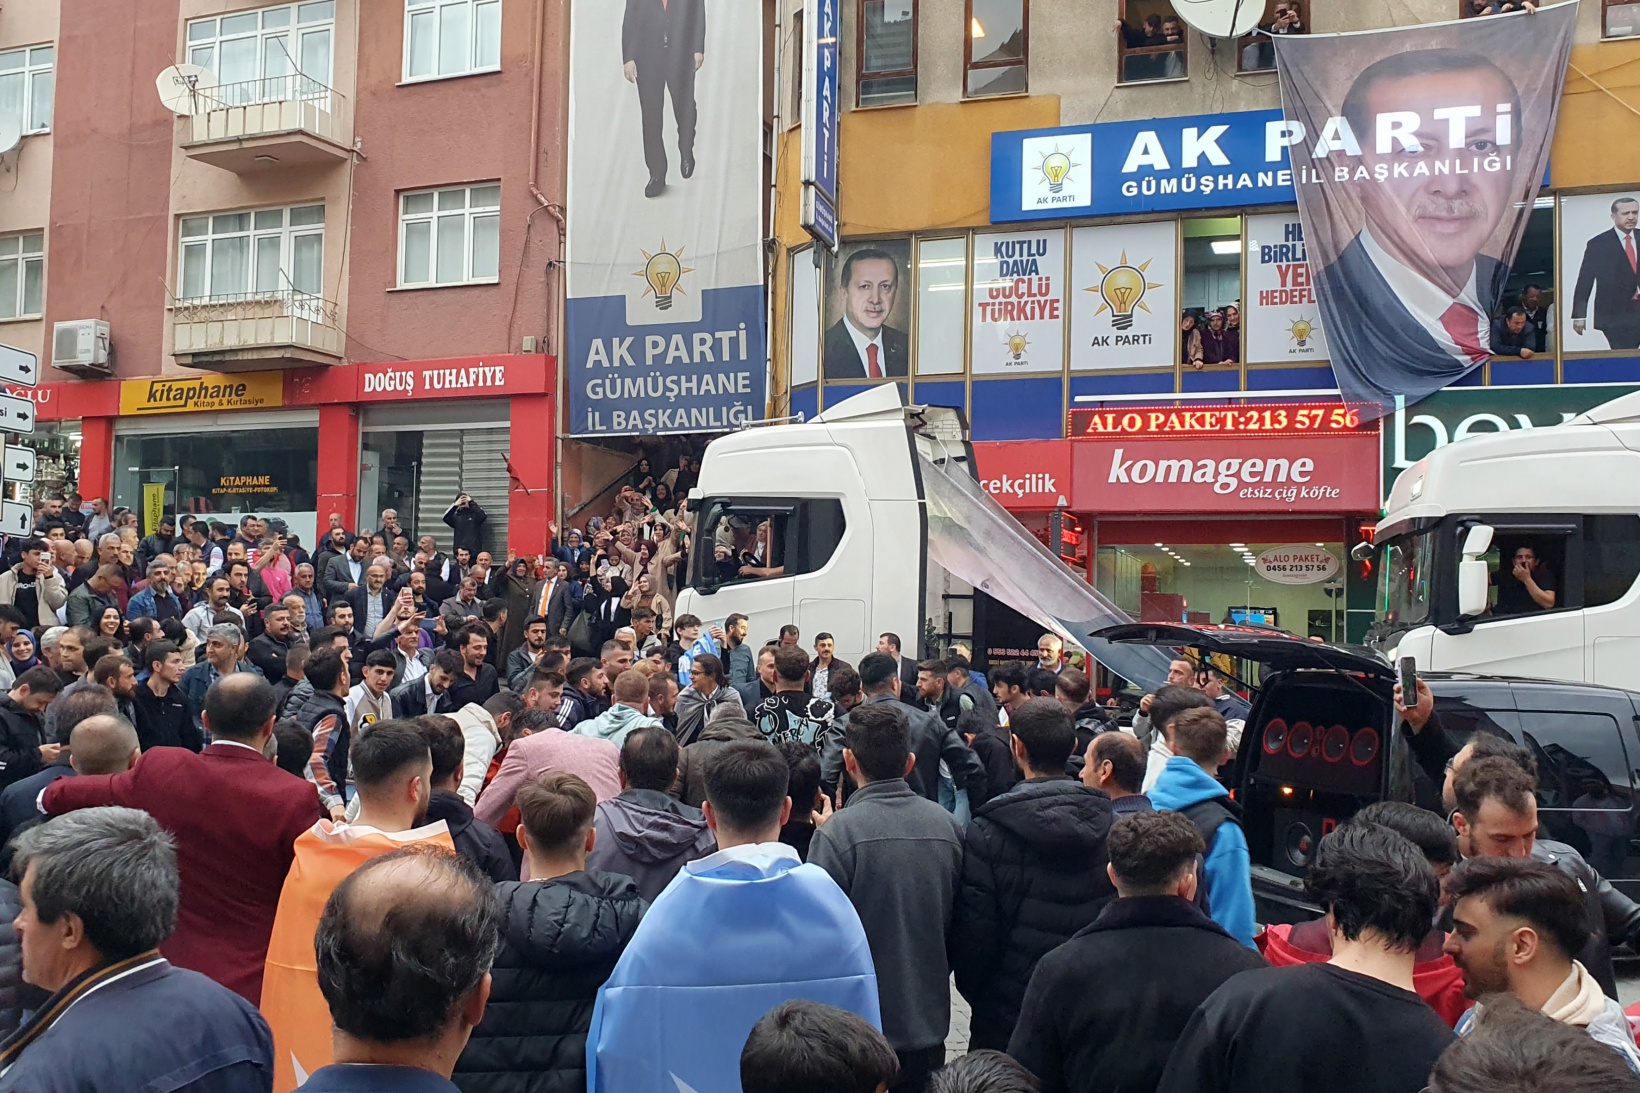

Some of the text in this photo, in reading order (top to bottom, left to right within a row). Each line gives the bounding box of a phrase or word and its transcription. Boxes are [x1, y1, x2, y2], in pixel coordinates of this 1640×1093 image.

[1121, 102, 1512, 174] AK PARTİ
[1121, 152, 1512, 197] GÜMÜŞHANE İL BAŞKANLIĞI
[1036, 194, 1075, 205] AK PARTİ
[993, 239, 1047, 259] KUTLU
[999, 258, 1040, 278] DAVA
[988, 276, 1051, 300] GÜÇLÜ
[978, 298, 1060, 323] TÜRKİYE
[585, 322, 748, 369] AK PARTİ
[1091, 334, 1152, 347] AK PARTİ
[364, 361, 505, 396] DOĞUŞ TUHAFİYE
[585, 371, 752, 402] GÜMÜŞHANE
[147, 379, 247, 408] kitaphane
[193, 399, 216, 409] Kitap
[218, 398, 224, 406] &
[587, 401, 753, 434] İL BAŞKANLIĞI
[1086, 408, 1360, 433] ALO PAKET:213 57 56
[220, 476, 271, 487] KİTAPHANE
[1107, 448, 1315, 494] komagene
[1239, 485, 1341, 502] etsiz çiğ köfte
[1266, 564, 1327, 572] 0456 213 57 56
[1293, 553, 1320, 563] PAKET
